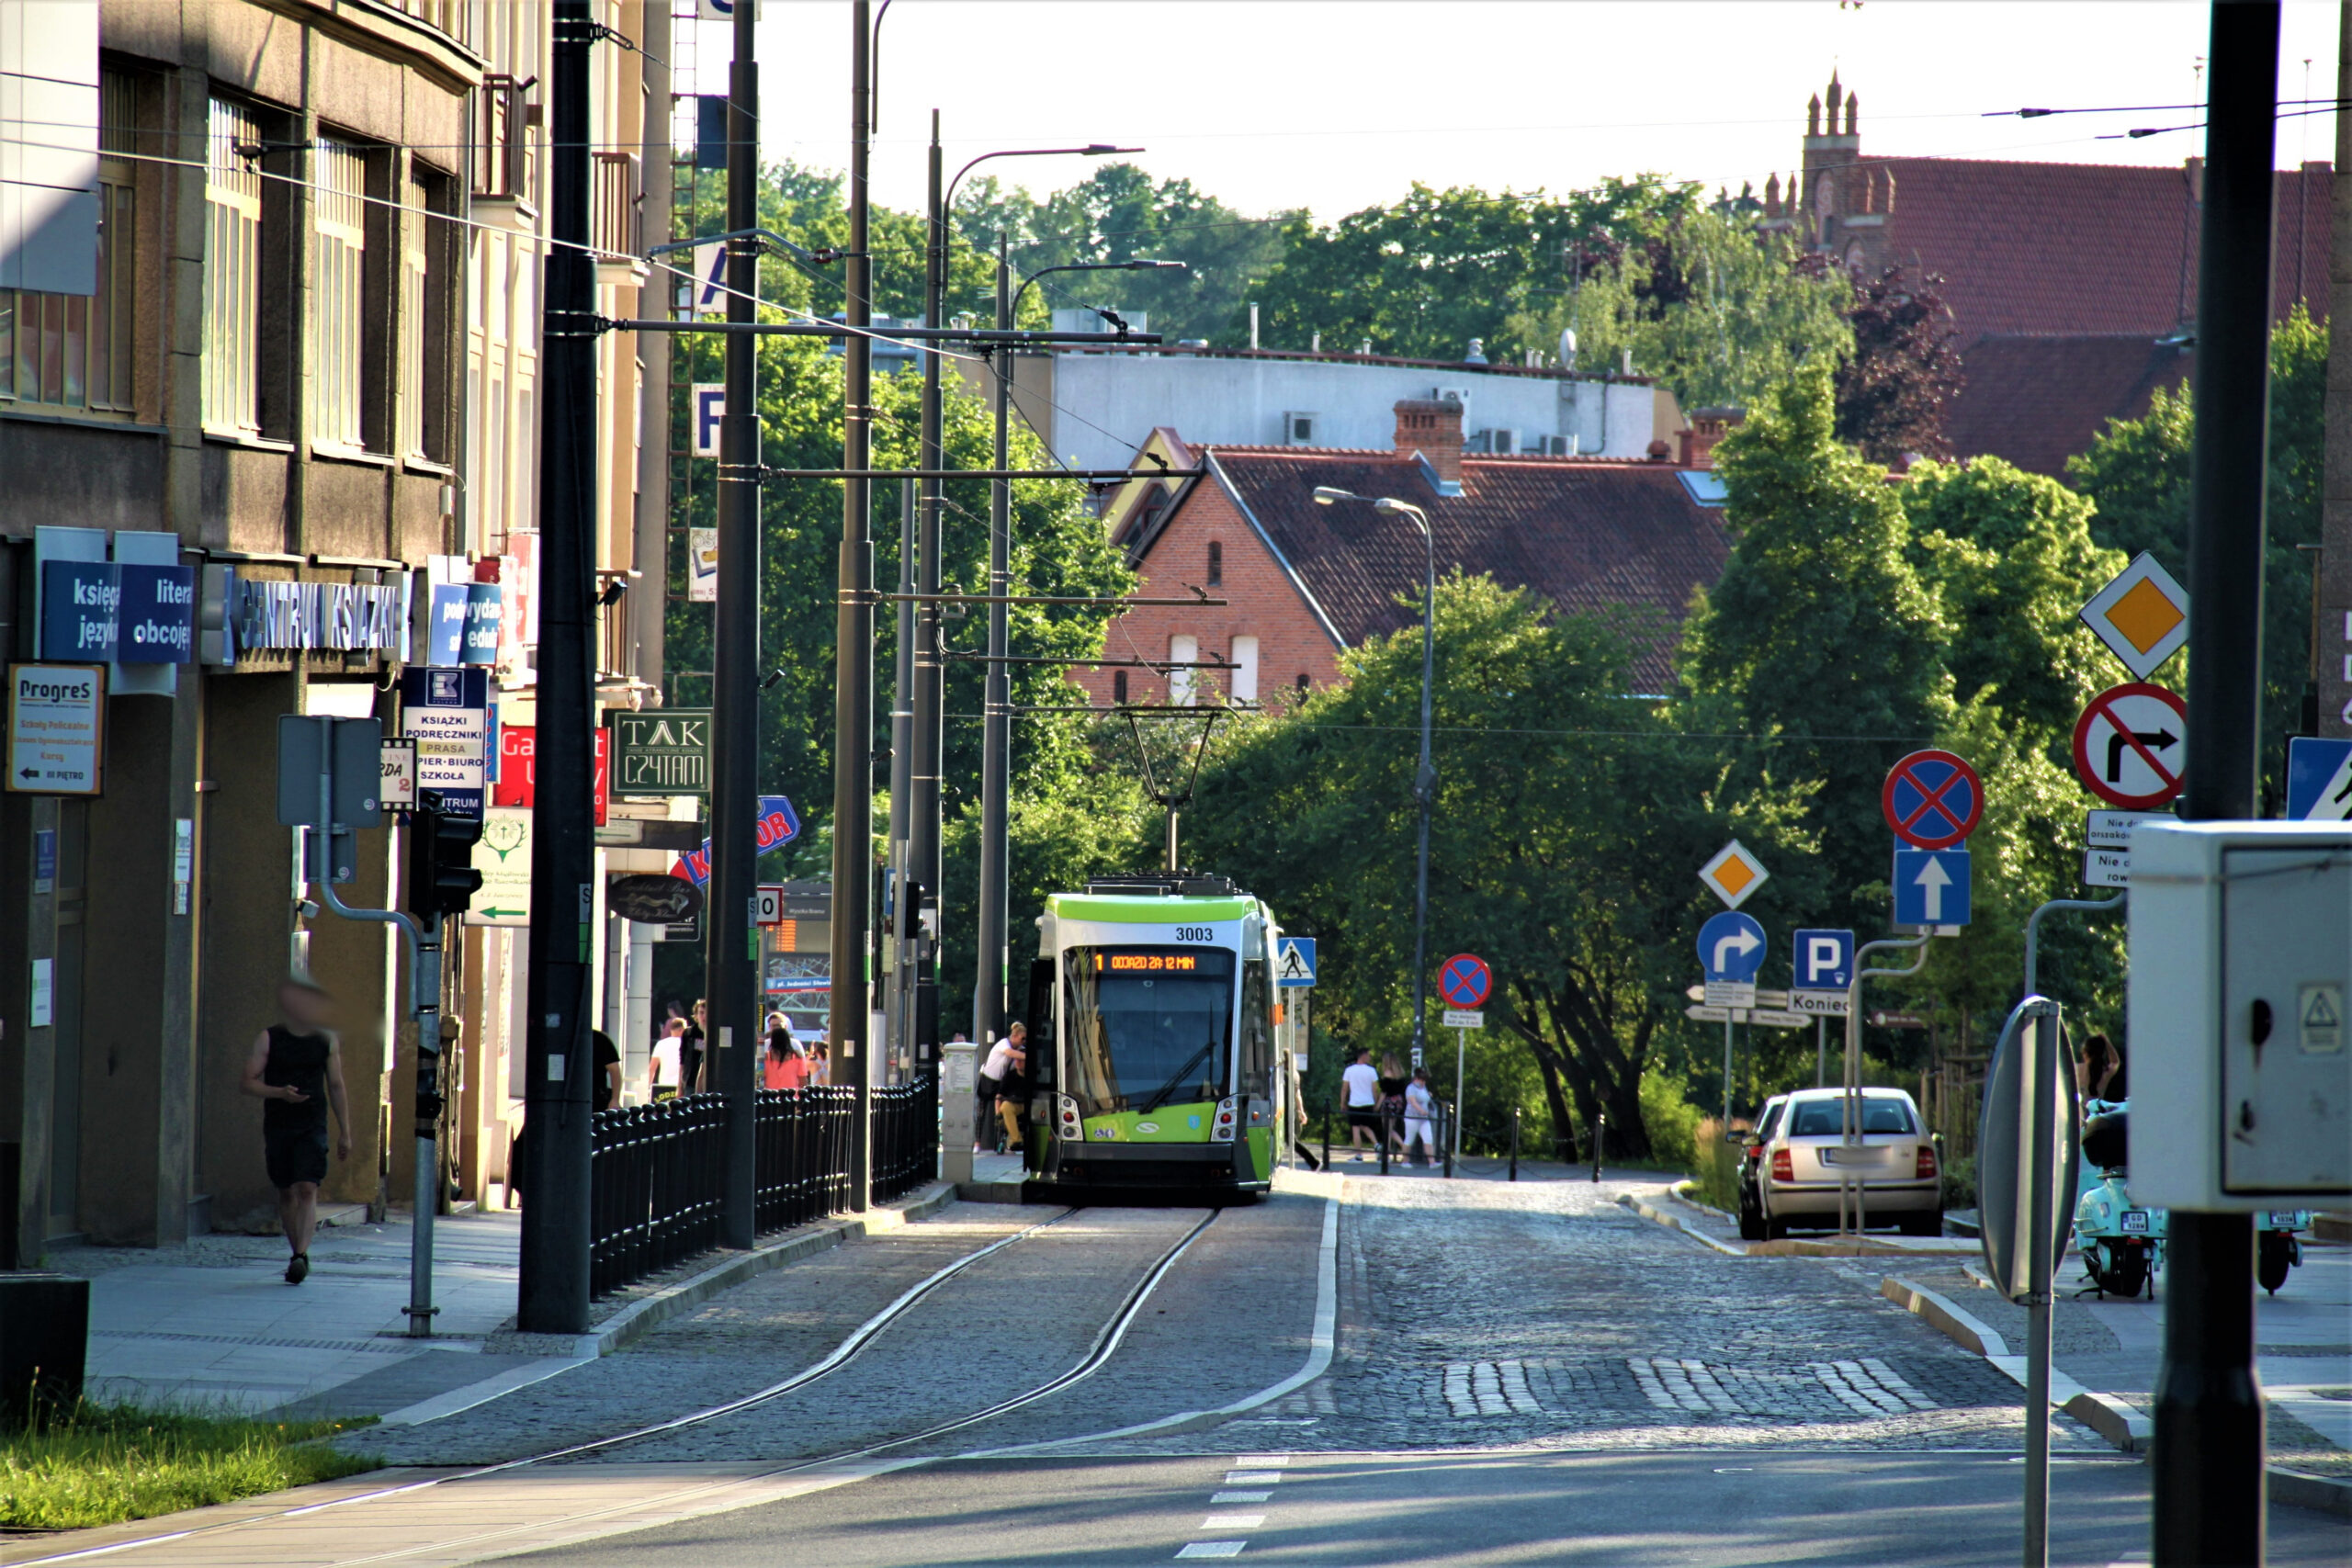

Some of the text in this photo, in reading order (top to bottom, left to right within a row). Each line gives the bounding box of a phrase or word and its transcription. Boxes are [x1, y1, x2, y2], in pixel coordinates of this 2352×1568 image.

[421, 715, 468, 727] KSIĄŻKI
[405, 729, 482, 740] PODRĘCZNIKI
[622, 719, 706, 747] TAK
[426, 745, 466, 753] PRASA
[420, 772, 465, 781] SZKOŁA
[399, 778, 411, 793] 2
[2108, 818, 2124, 827] Nie
[2098, 854, 2119, 866] Nie
[1175, 927, 1214, 942] 3003
[1094, 953, 1103, 971] 1
[1165, 956, 1176, 970] 12
[1176, 956, 1195, 970] MIN
[1808, 937, 1841, 982] P
